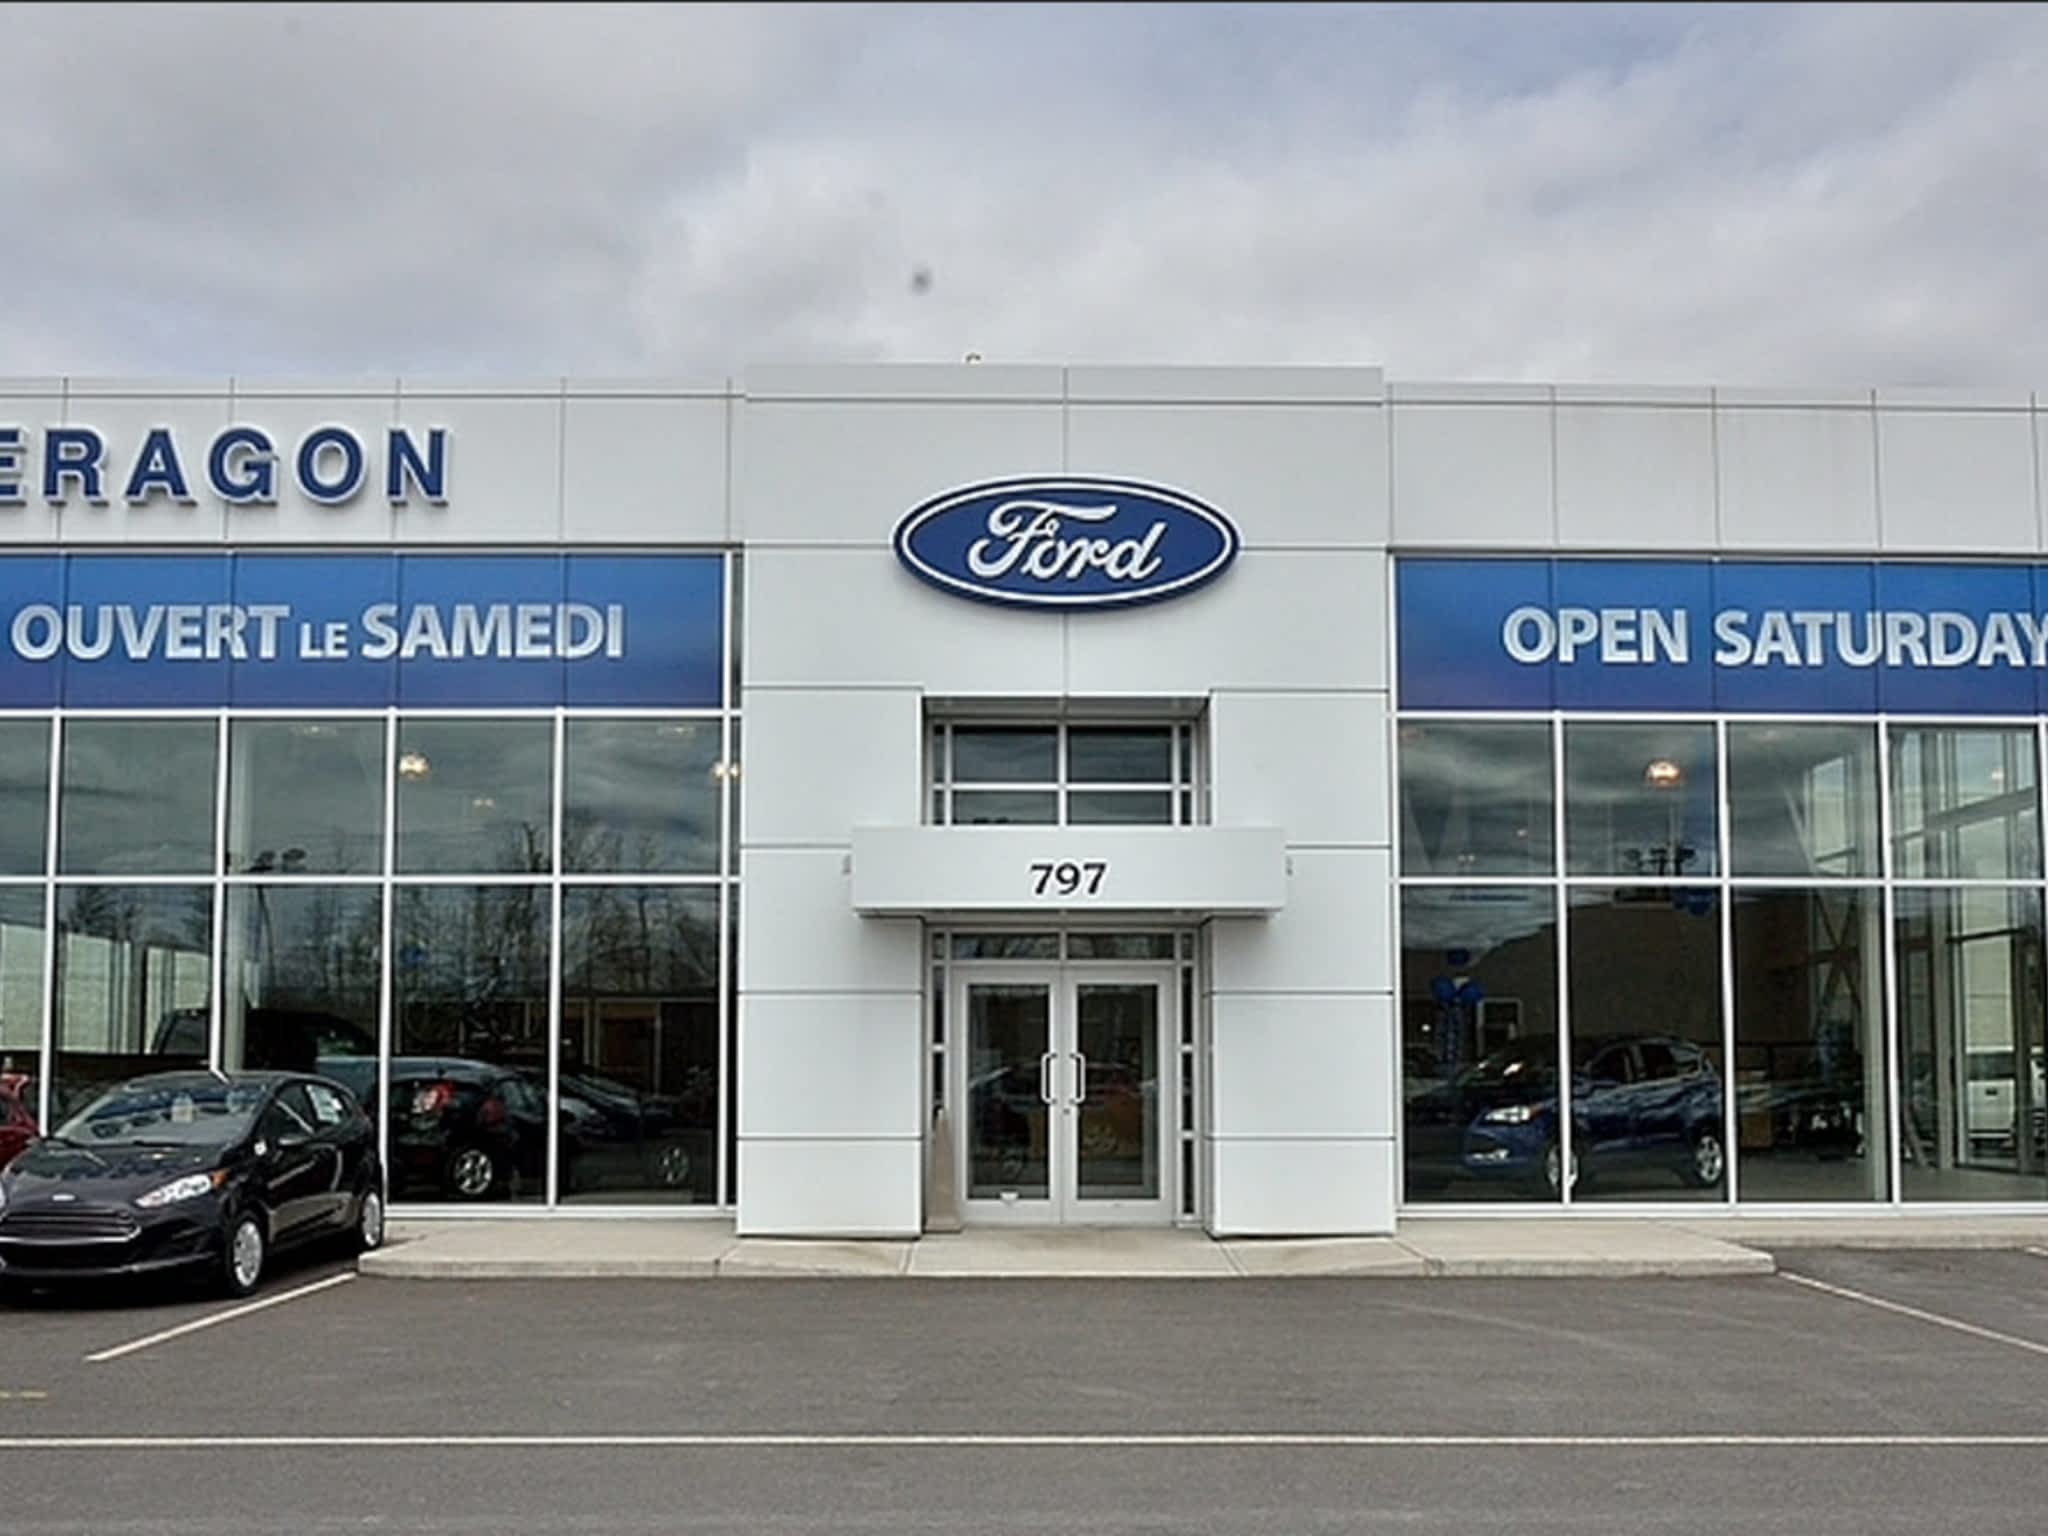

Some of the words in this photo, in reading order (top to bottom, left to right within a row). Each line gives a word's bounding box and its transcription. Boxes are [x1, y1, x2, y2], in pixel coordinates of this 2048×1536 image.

[967, 500, 1167, 580] Ford
[10, 604, 290, 660] OUVERT
[301, 623, 348, 658] LE
[361, 604, 624, 659] SAMEDI
[1503, 607, 1688, 664] OPEN
[1714, 611, 2048, 667] SATURDAY
[1030, 862, 1107, 895] 797
